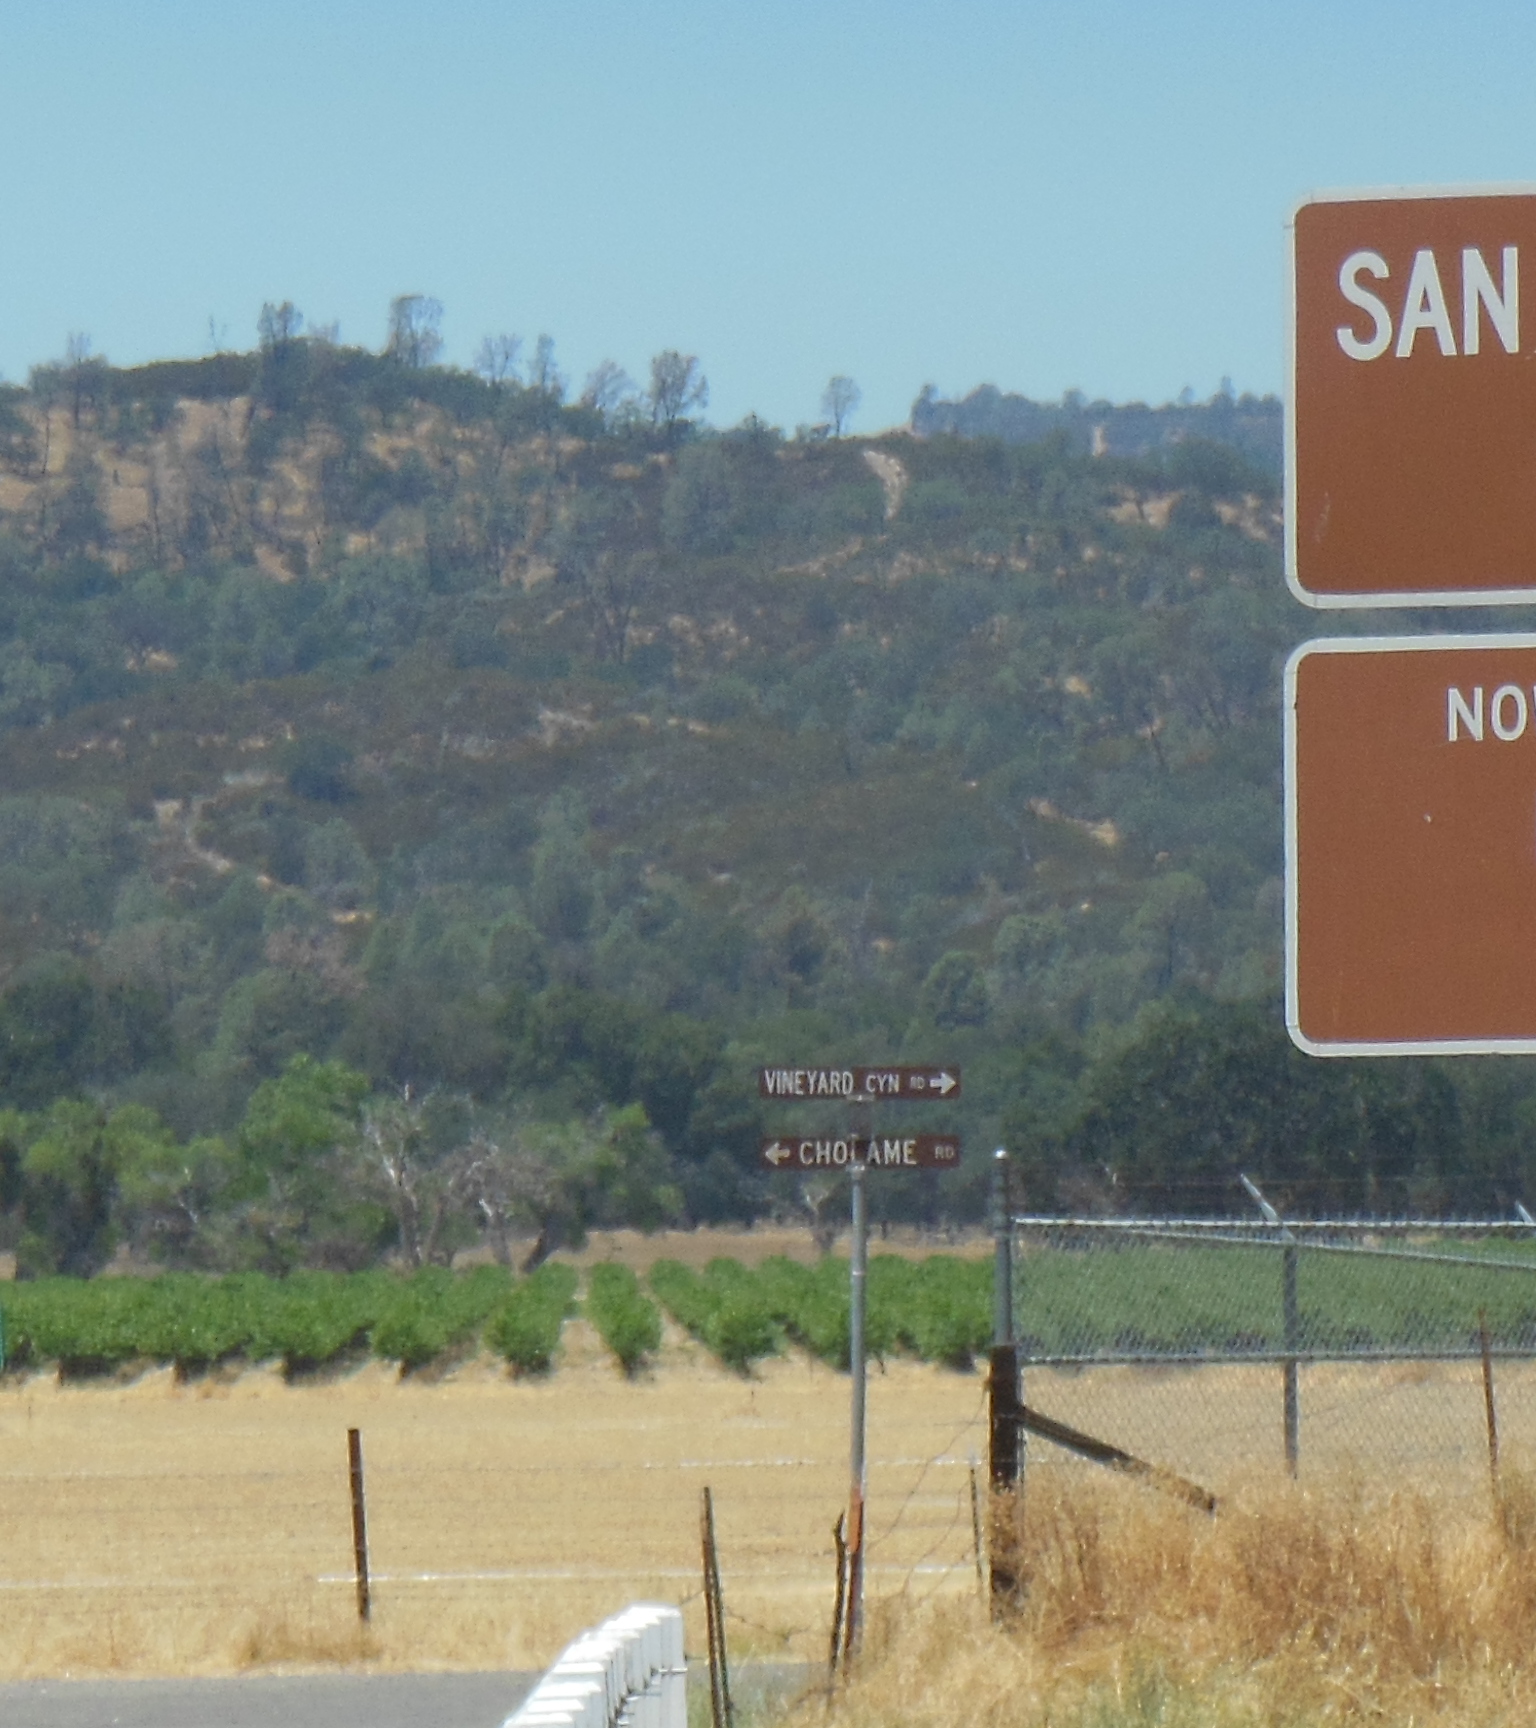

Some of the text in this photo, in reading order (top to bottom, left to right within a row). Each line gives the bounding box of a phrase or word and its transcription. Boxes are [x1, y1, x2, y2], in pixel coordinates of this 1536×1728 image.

[1336, 246, 1520, 362] SAN
[764, 1069, 854, 1095] VINEYARD
[865, 1074, 900, 1093] CYN
[934, 1146, 955, 1159] RD
